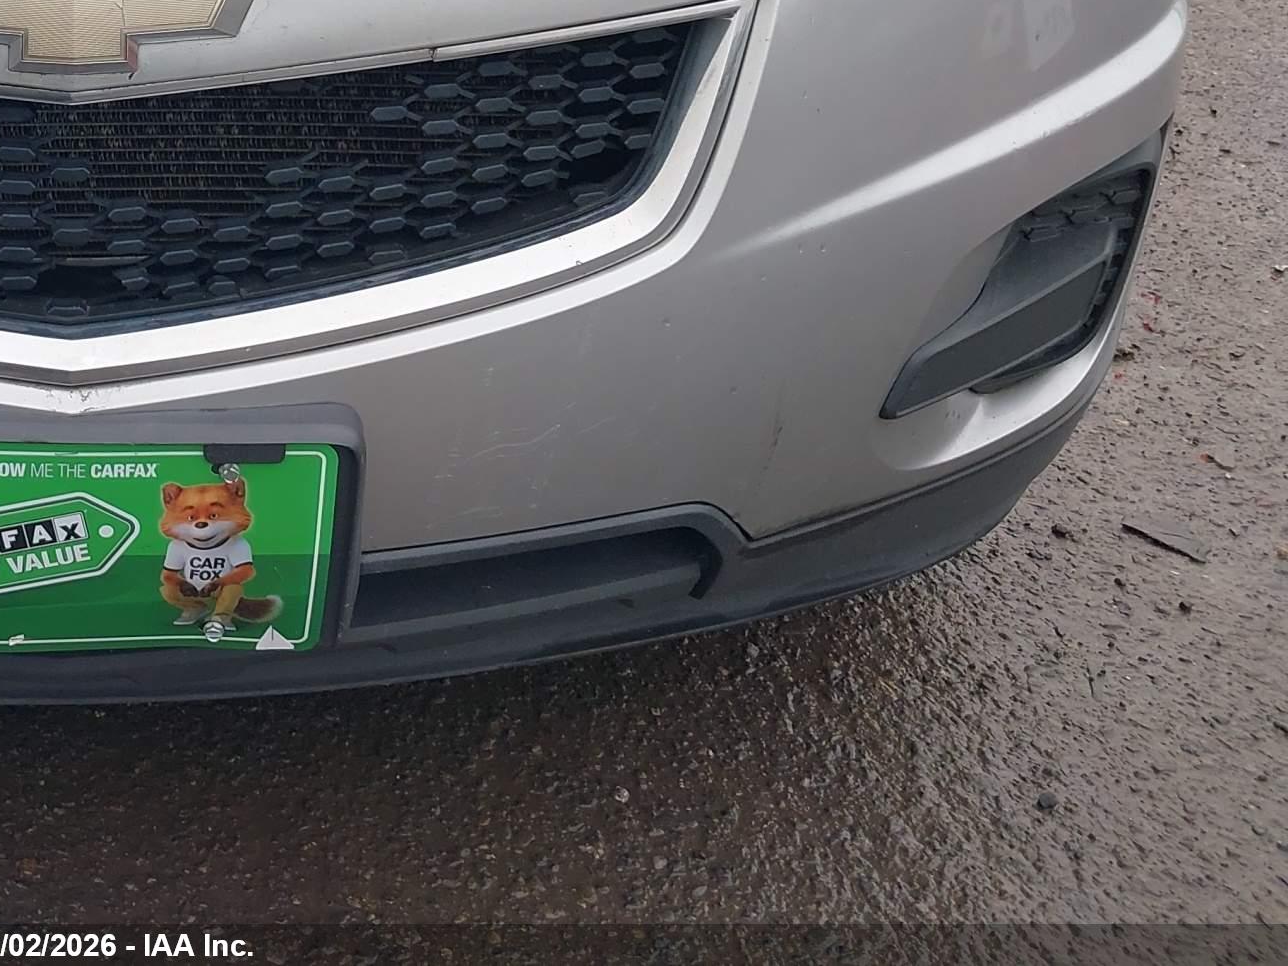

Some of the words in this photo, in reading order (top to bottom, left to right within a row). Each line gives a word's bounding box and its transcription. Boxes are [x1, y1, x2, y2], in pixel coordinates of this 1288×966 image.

[30, 462, 54, 477] ME
[59, 462, 86, 478] THE
[90, 462, 158, 478] CARFAX
[6, 543, 91, 575] VALUE
[189, 557, 226, 569] CAR
[189, 569, 223, 581] FOX
